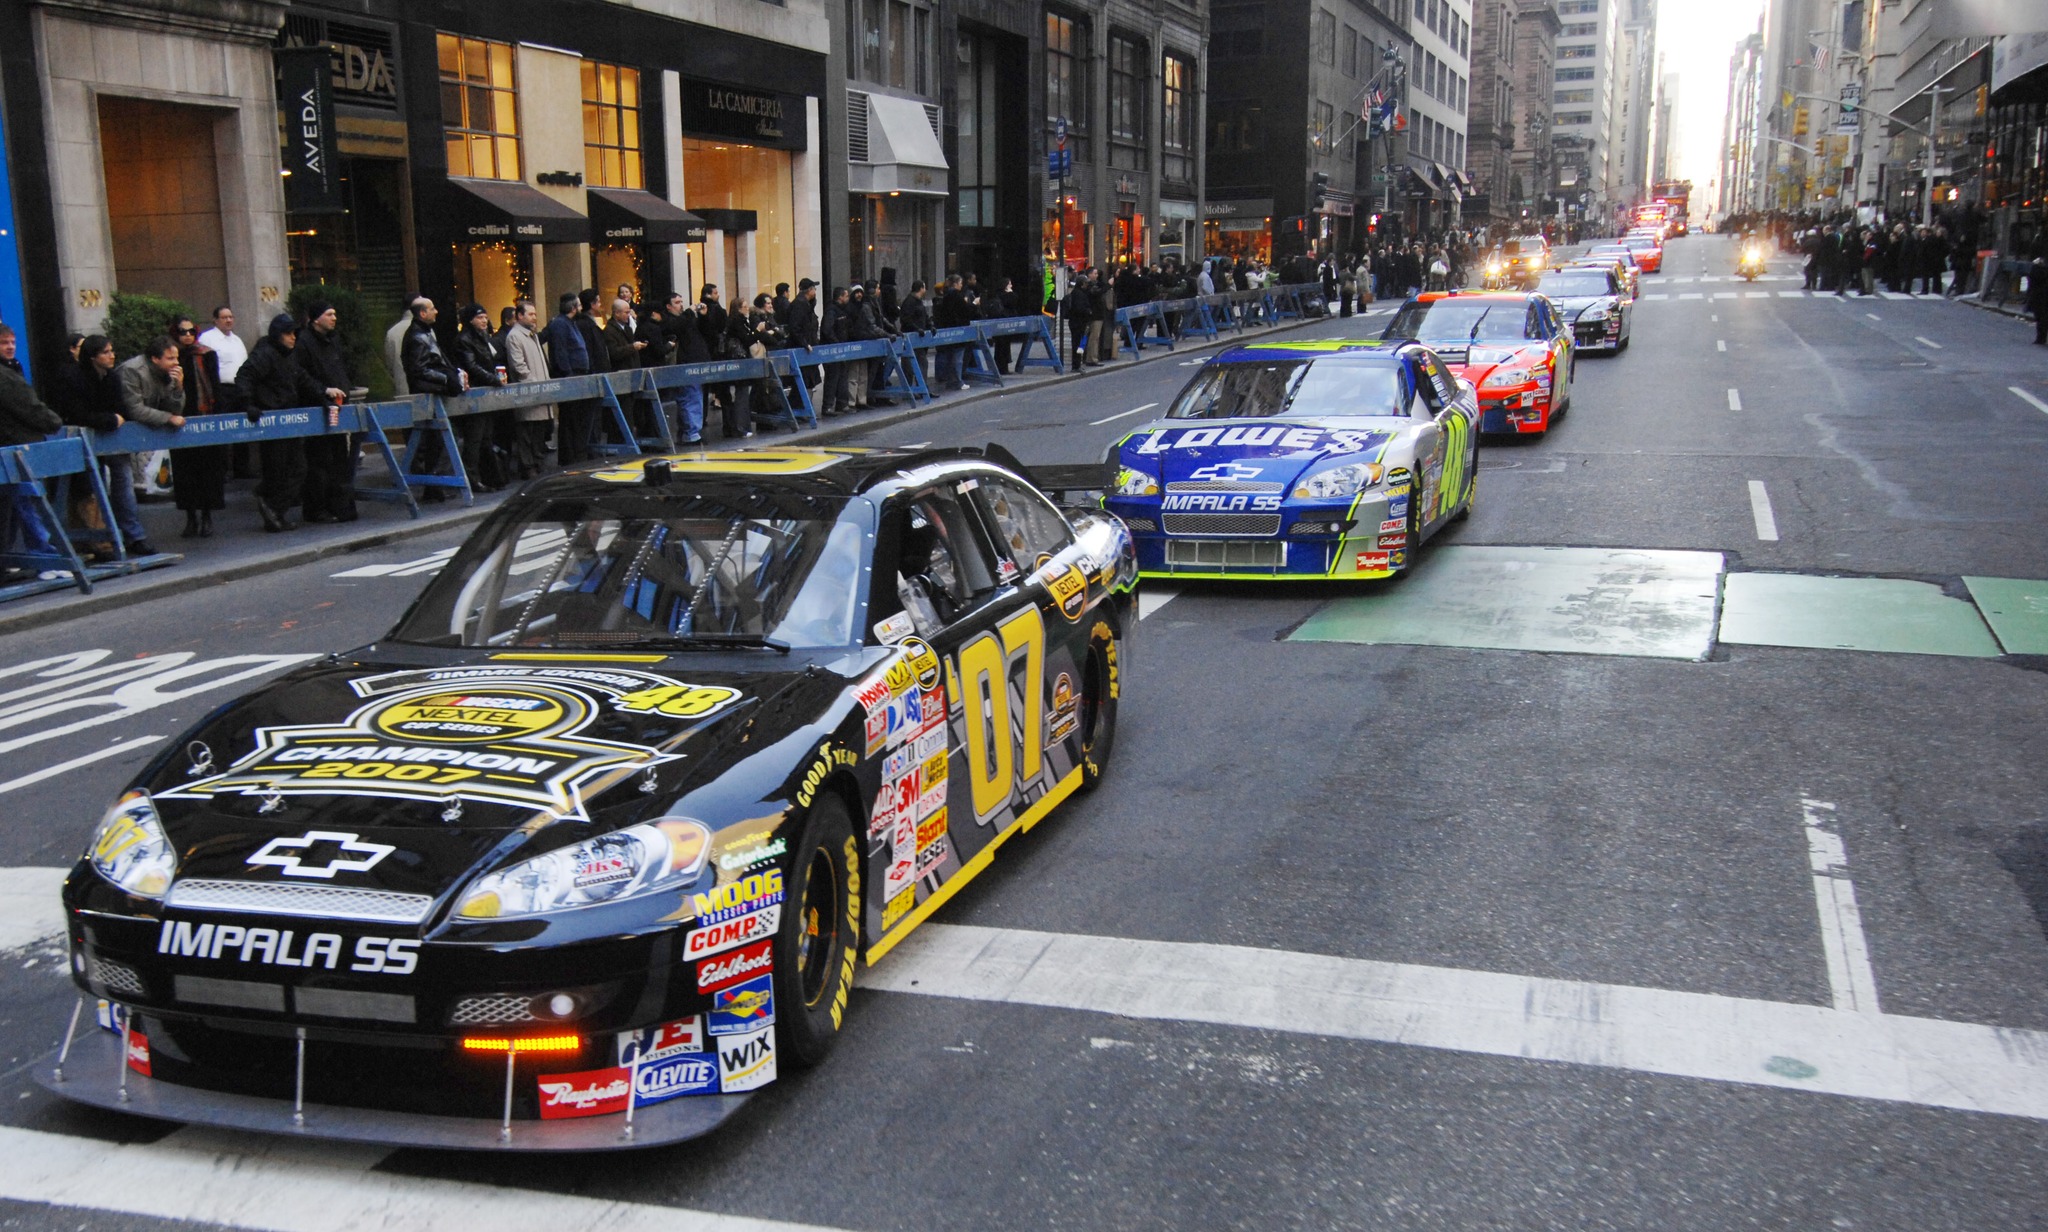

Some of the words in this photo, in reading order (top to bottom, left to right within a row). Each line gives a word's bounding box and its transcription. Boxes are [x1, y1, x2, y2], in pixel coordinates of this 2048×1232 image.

[709, 88, 724, 110] LA
[725, 92, 783, 119] CAMICERIA
[301, 88, 321, 174] AVEDA
[468, 224, 510, 236] cellini
[517, 224, 543, 235] cellini
[605, 226, 644, 238] cellini
[220, 418, 239, 432] LINE
[259, 415, 276, 428] NOT
[279, 412, 310, 425] CROSS
[1161, 495, 1247, 512] IMPALA
[1250, 495, 1284, 512] SS
[1056, 575, 1080, 598] NEXTEL
[430, 668, 530, 680] JIMMIE
[533, 668, 645, 688] JOHNSON
[455, 696, 545, 710] NASCAR
[619, 686, 733, 715] 48
[401, 722, 435, 731] CUP
[437, 722, 502, 735] SERIES
[411, 708, 522, 724] NEXTEL
[274, 746, 556, 774] CHAMPION
[300, 762, 482, 783] 2007
[897, 768, 920, 813] 3M
[896, 815, 914, 845] EA
[916, 812, 945, 851] Stant
[720, 838, 787, 871] Gatorback
[693, 867, 783, 918] MOOG
[702, 902, 749, 926] CHASSIS
[752, 891, 784, 910] PARTS
[158, 920, 343, 969] IMPALA
[351, 936, 422, 975] SS
[689, 916, 757, 952] COMP
[698, 945, 773, 987] Edelbrock
[645, 1044, 700, 1061] PISTONS
[722, 1031, 772, 1073] WIX
[637, 1062, 711, 1093] CLEVITE
